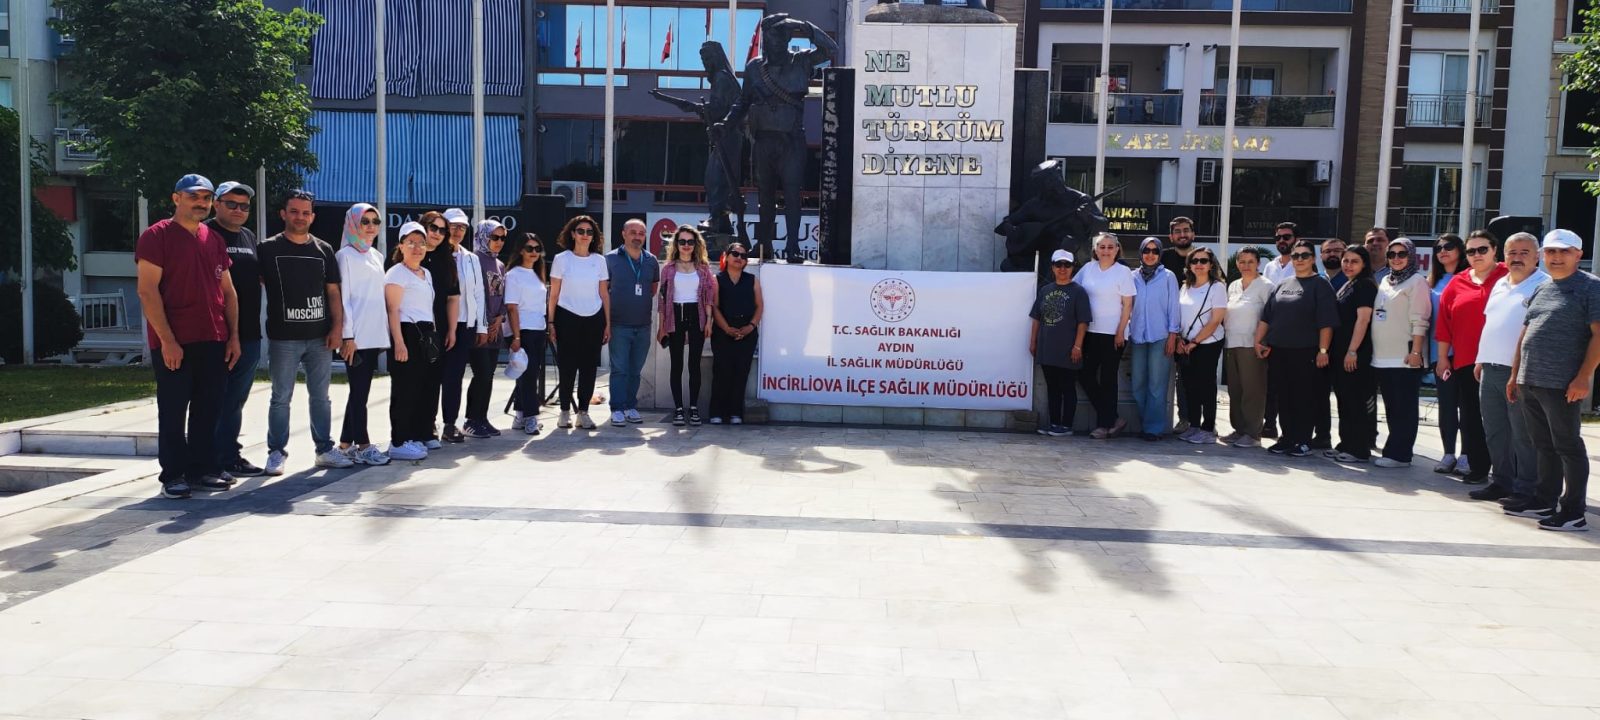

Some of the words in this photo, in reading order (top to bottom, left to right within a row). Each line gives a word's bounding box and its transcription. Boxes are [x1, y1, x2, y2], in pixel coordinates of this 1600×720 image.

[865, 50, 910, 72] NE
[864, 85, 978, 107] MUTLU
[862, 112, 1004, 142] TÜRKÜM
[862, 147, 982, 175] DİYENE
[1103, 207, 1148, 219] AVUKAT
[307, 296, 323, 309] LOVE
[287, 307, 324, 320] MOSCHINO
[832, 325, 852, 335] T.C.
[855, 325, 895, 336] SAĞLIK
[898, 327, 961, 338] BAKANLIĞI
[877, 342, 915, 353] AYDIN
[827, 356, 838, 367] İL
[840, 357, 882, 368] SAĞLIK
[885, 358, 964, 371] MÜDÜRLÜĞÜ
[762, 373, 843, 393] İNCİRLİOVA
[846, 376, 875, 397] İLÇE
[878, 378, 930, 395] SAĞLIK
[933, 379, 1028, 398] MÜDÜRLÜĞÜ
